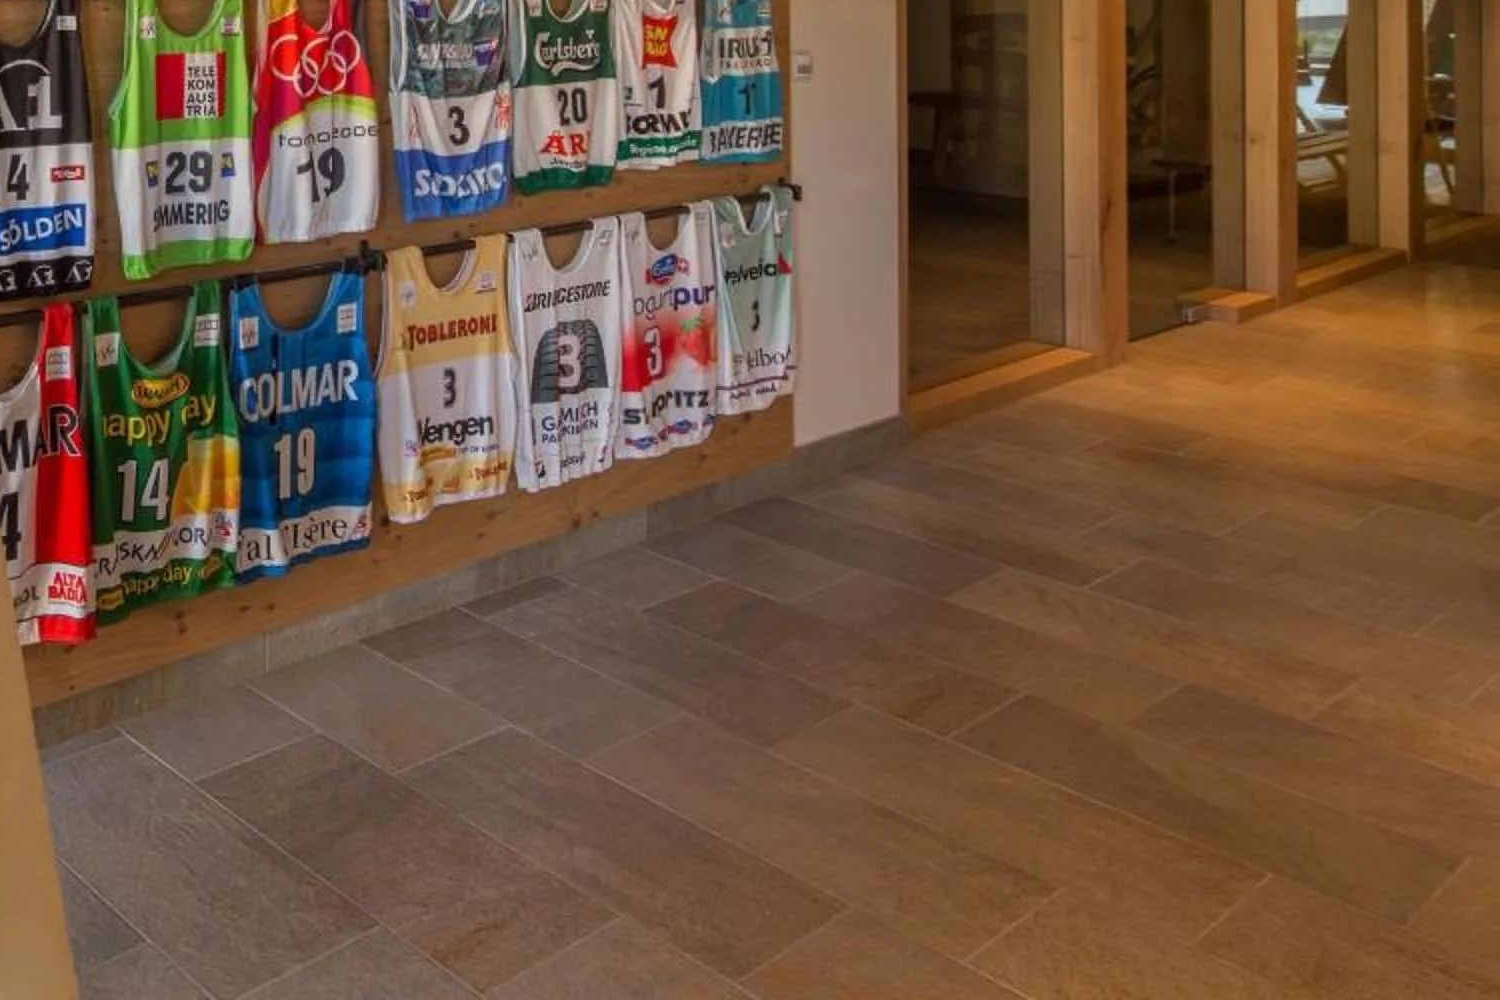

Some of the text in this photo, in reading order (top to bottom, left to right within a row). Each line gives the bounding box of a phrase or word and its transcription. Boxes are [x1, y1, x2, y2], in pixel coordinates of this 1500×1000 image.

[449, 105, 470, 147] 3
[557, 87, 587, 127] 20
[7, 154, 31, 201] 4
[165, 151, 213, 195] 29
[558, 333, 582, 392] 3
[645, 327, 665, 378] 3
[239, 359, 359, 423] COLMAR
[274, 427, 316, 500] 19
[117, 457, 171, 522] 14
